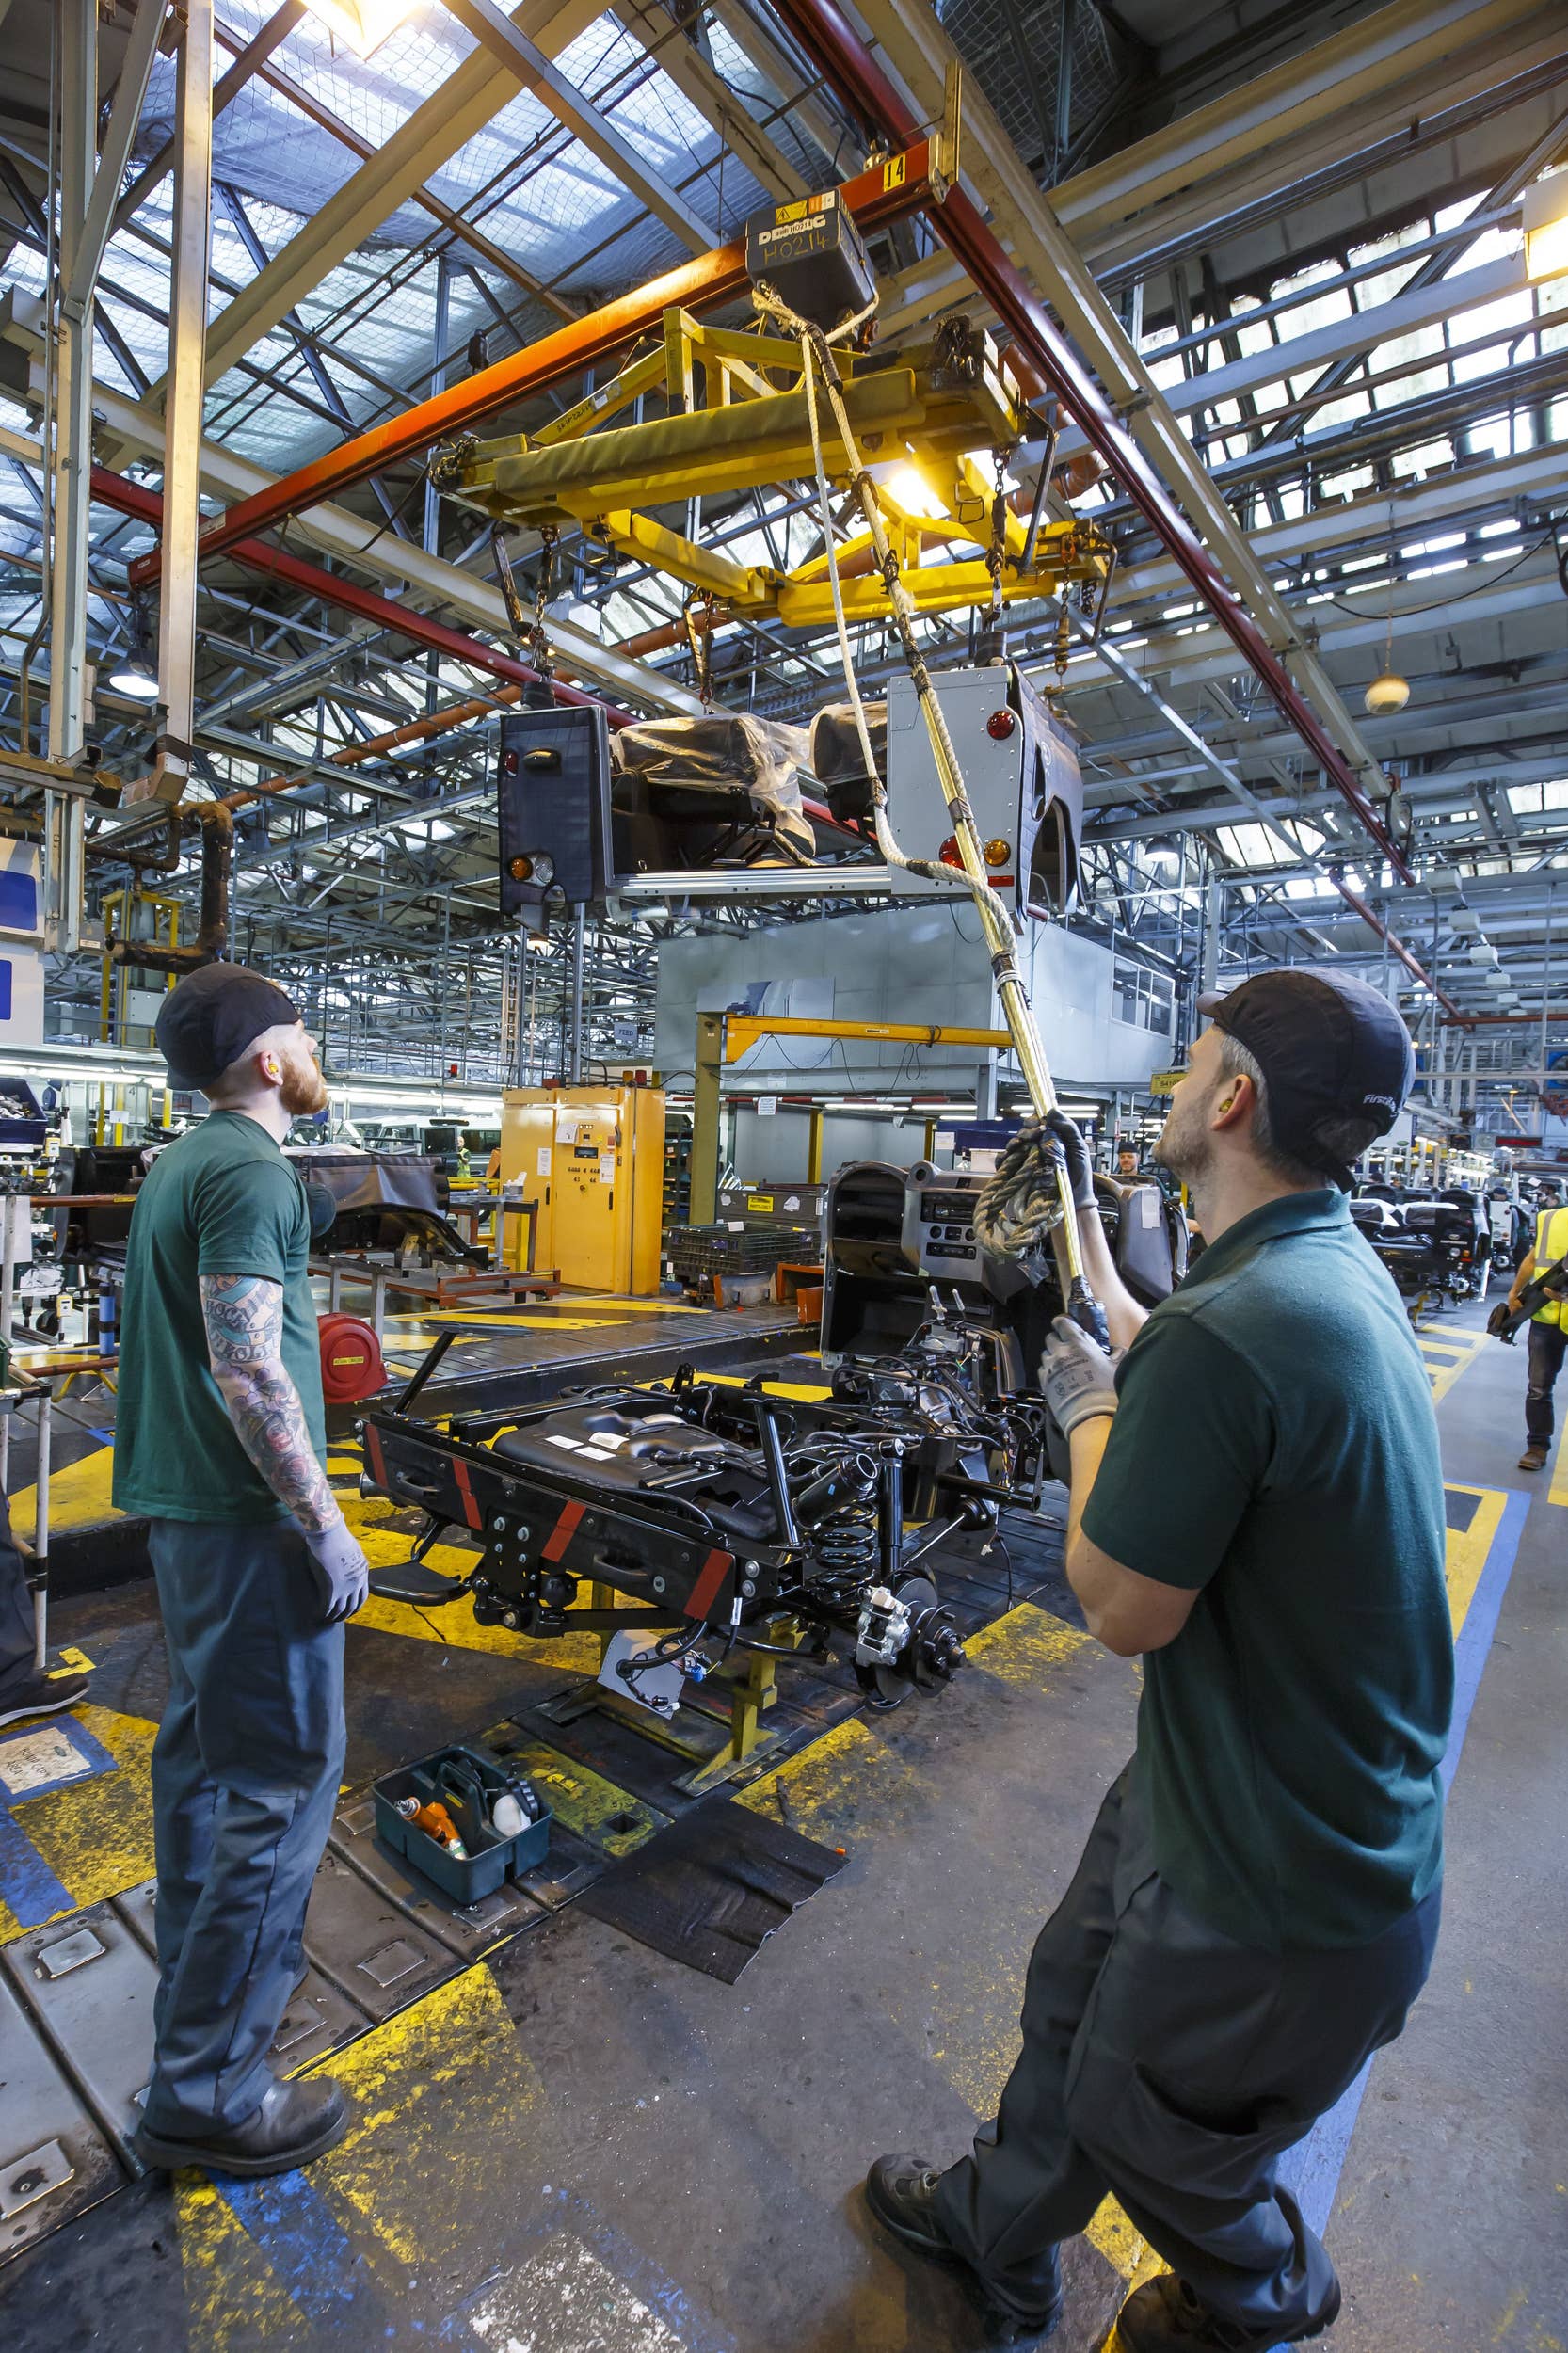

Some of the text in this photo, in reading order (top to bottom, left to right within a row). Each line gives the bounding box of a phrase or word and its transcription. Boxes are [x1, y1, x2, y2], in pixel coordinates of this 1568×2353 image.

[887, 156, 904, 187] 14
[618, 1029, 634, 1037] FEED
[128, 1086, 136, 1096] 4
